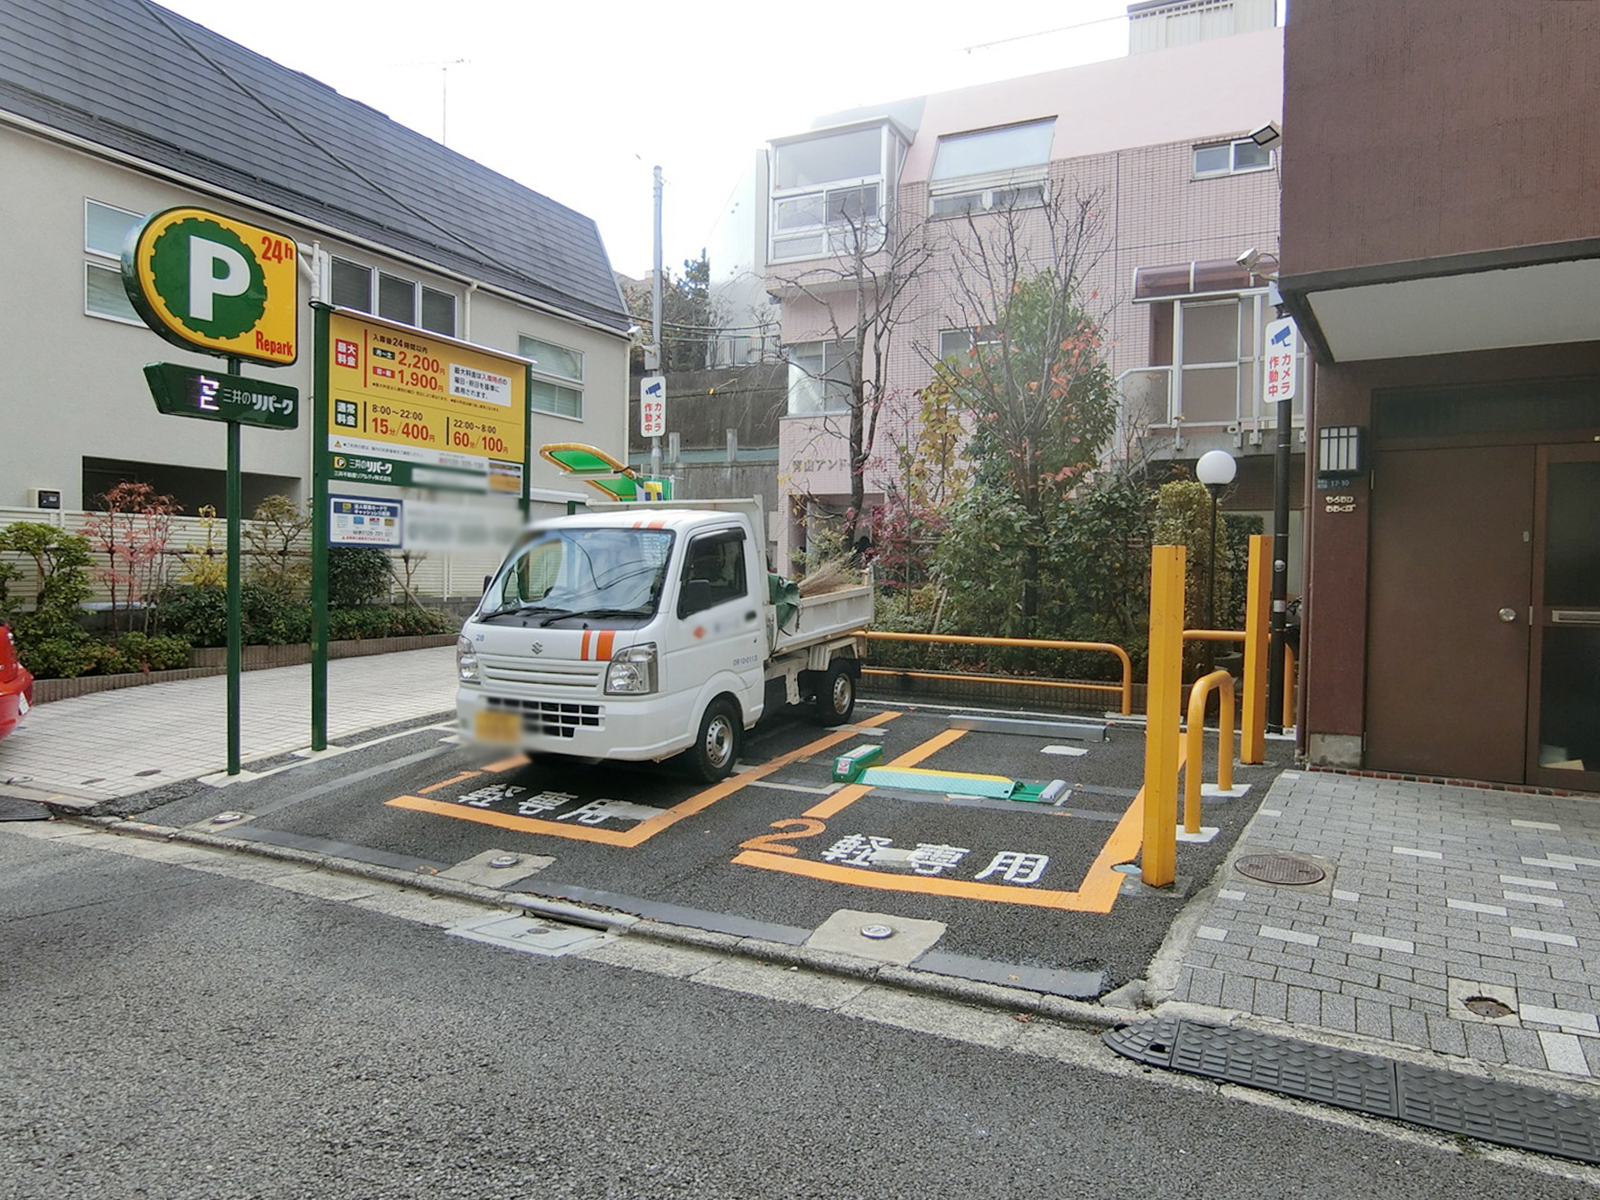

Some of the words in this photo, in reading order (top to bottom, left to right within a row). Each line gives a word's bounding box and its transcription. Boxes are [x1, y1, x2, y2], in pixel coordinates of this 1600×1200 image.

[261, 235, 293, 264] 24h
[189, 234, 251, 322] P
[255, 330, 293, 357] Repark
[337, 353, 357, 367] 料金
[398, 350, 445, 375] 2,200円
[1280, 353, 1292, 395] カメラ
[398, 369, 444, 392] 1,900円
[1268, 355, 1280, 397] 作動中
[223, 387, 294, 415] 三井のリパーク
[644, 402, 653, 433] 作動中
[654, 402, 662, 432] カメラ
[349, 458, 393, 475] 三井のリパーク
[738, 817, 827, 855] 2
[820, 833, 1050, 884] 軽専用
